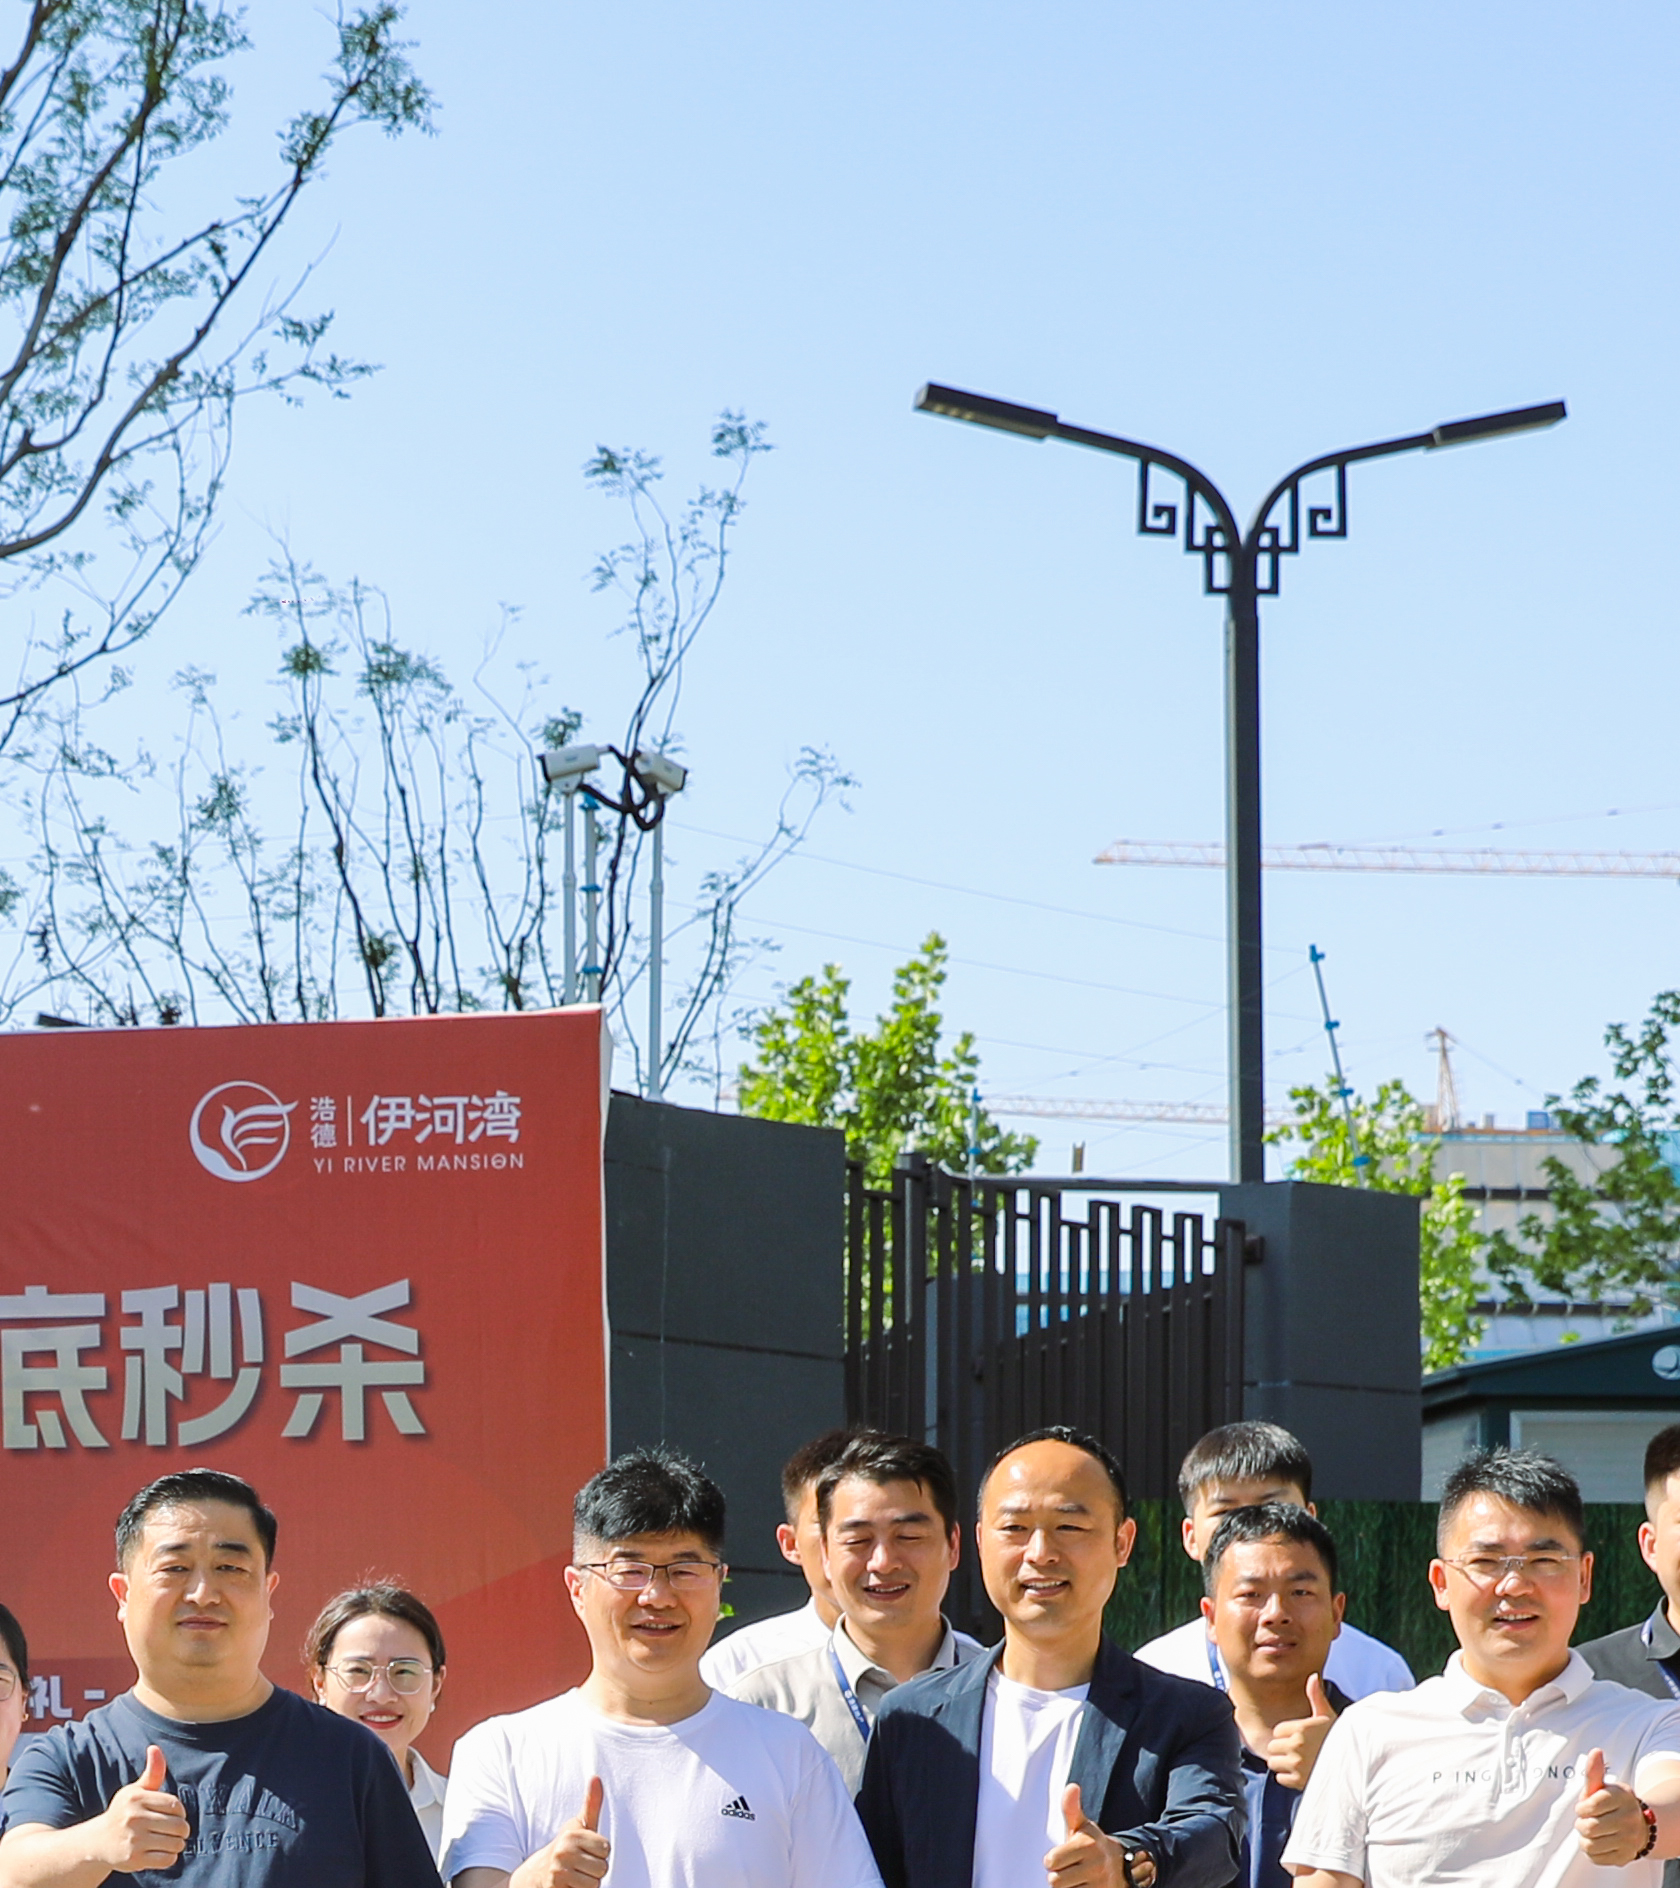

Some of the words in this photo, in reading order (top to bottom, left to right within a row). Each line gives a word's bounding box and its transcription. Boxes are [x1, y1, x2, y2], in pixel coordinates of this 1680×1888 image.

[310, 1096, 337, 1148] 浩德
[360, 1090, 522, 1145] 伊河湾
[313, 1159, 332, 1174] YI
[344, 1157, 406, 1173] RIVER
[417, 1153, 524, 1171] MANSION
